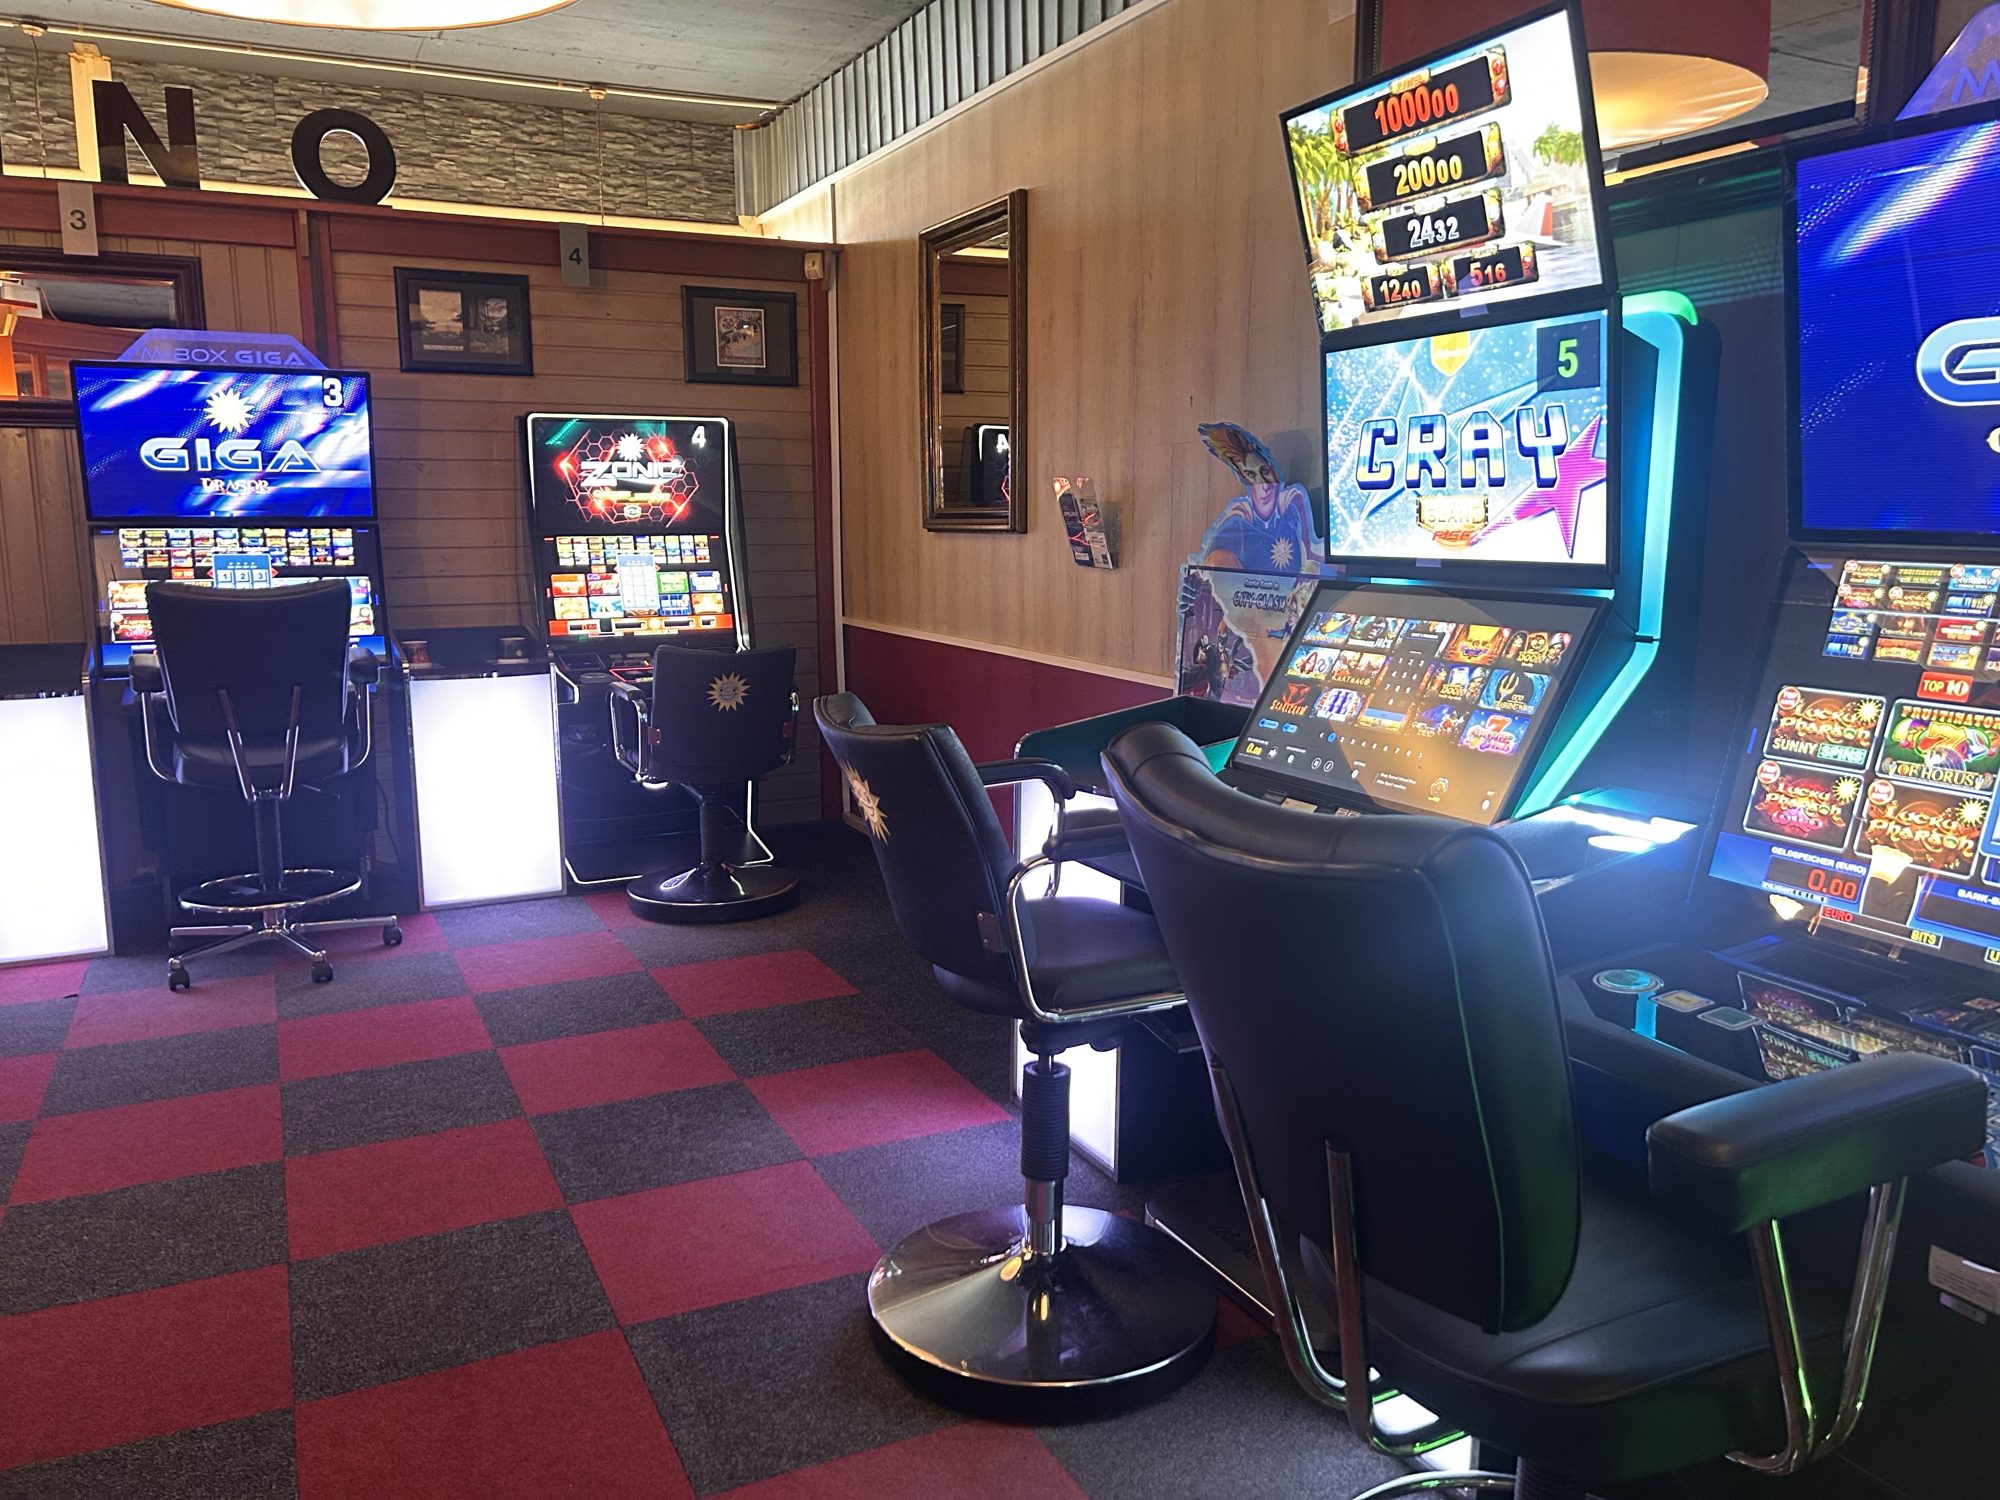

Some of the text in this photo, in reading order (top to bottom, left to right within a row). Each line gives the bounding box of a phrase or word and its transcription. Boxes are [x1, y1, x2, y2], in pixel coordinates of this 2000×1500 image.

[70, 210, 87, 230] 3
[1407, 215, 1460, 248] 2432
[568, 248, 583, 264] 4
[1470, 262, 1506, 286] 516
[1380, 279, 1421, 302] 1240
[174, 348, 227, 363] BOX
[234, 350, 305, 366] GIGA
[1557, 339, 1578, 378] 5
[323, 378, 343, 407] 3
[691, 425, 707, 448] 4
[1355, 404, 1568, 490] CRAY
[140, 437, 322, 473] GIGA
[580, 460, 684, 487] ZONIC
[1923, 680, 1969, 696] TOP 10
[1918, 721, 1967, 754] 7
[1772, 738, 1863, 762] SUNNY SPINS
[1897, 763, 1976, 787] OF HORUS
[1771, 846, 1867, 876] GELDSPEICHER (EURO)
[1808, 869, 1857, 899] 0.00
[1957, 888, 2000, 907] BANK-B
[1824, 907, 1854, 923] EURO
[1910, 929, 1937, 945] BITS
